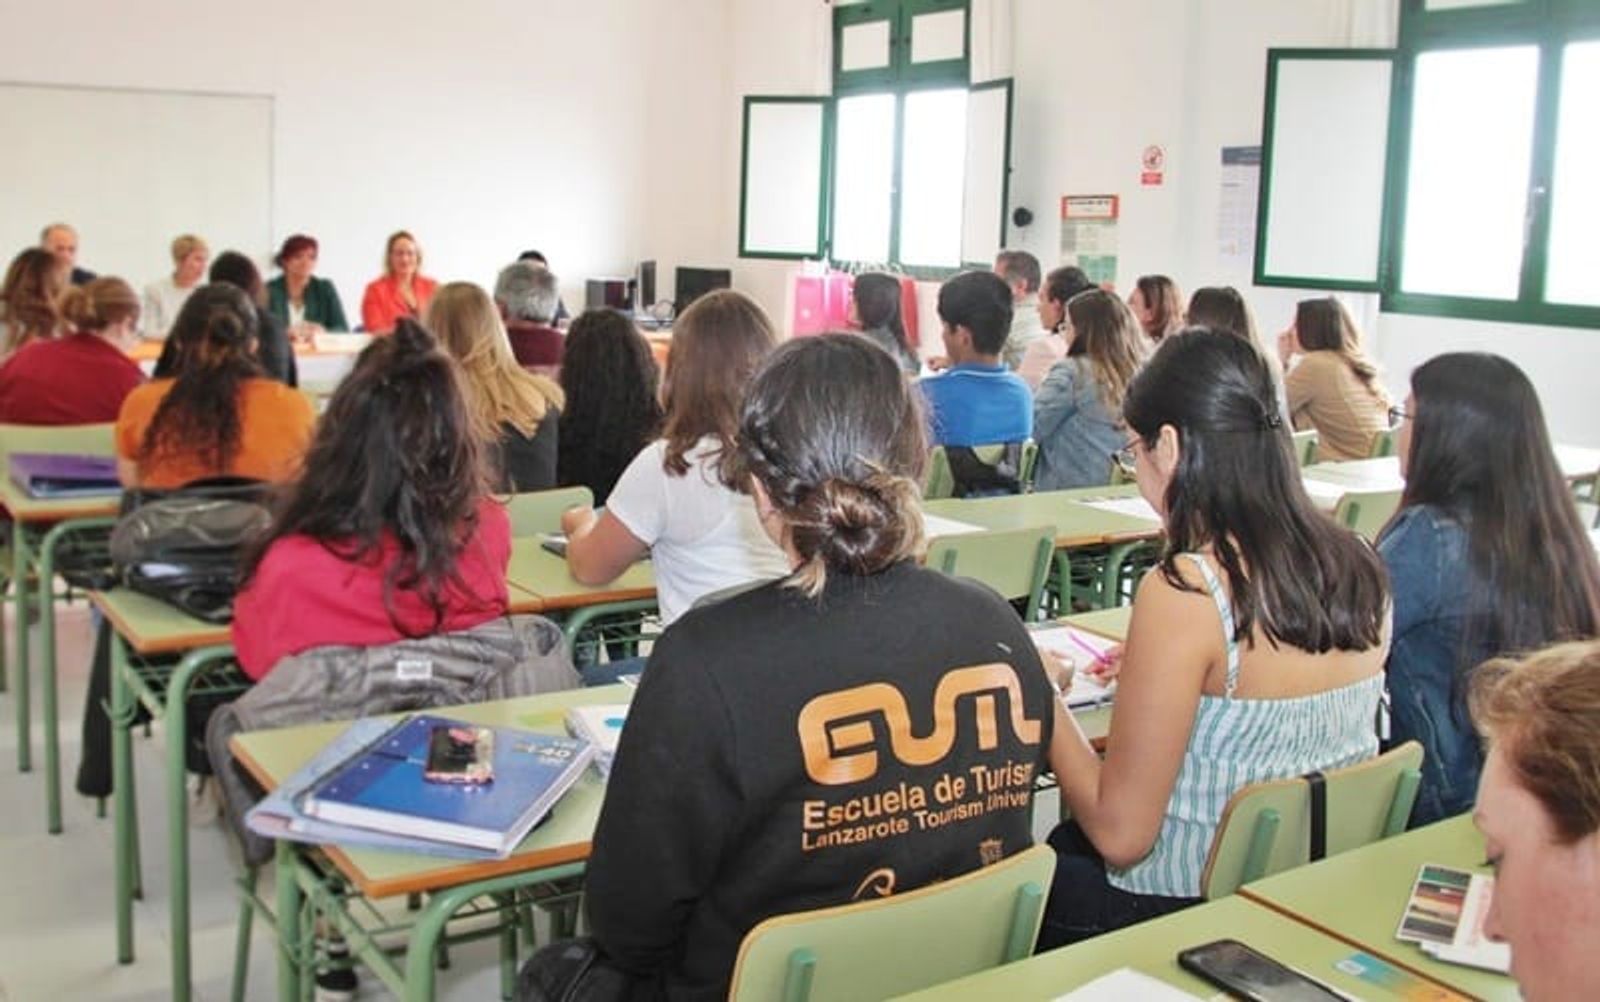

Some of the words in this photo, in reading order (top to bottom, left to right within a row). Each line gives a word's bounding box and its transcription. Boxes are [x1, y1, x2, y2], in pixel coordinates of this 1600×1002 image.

[801, 817, 910, 850] Lanzarote
[913, 800, 984, 830] Tourism
[803, 782, 926, 830] Escuela
[934, 773, 966, 803] de
